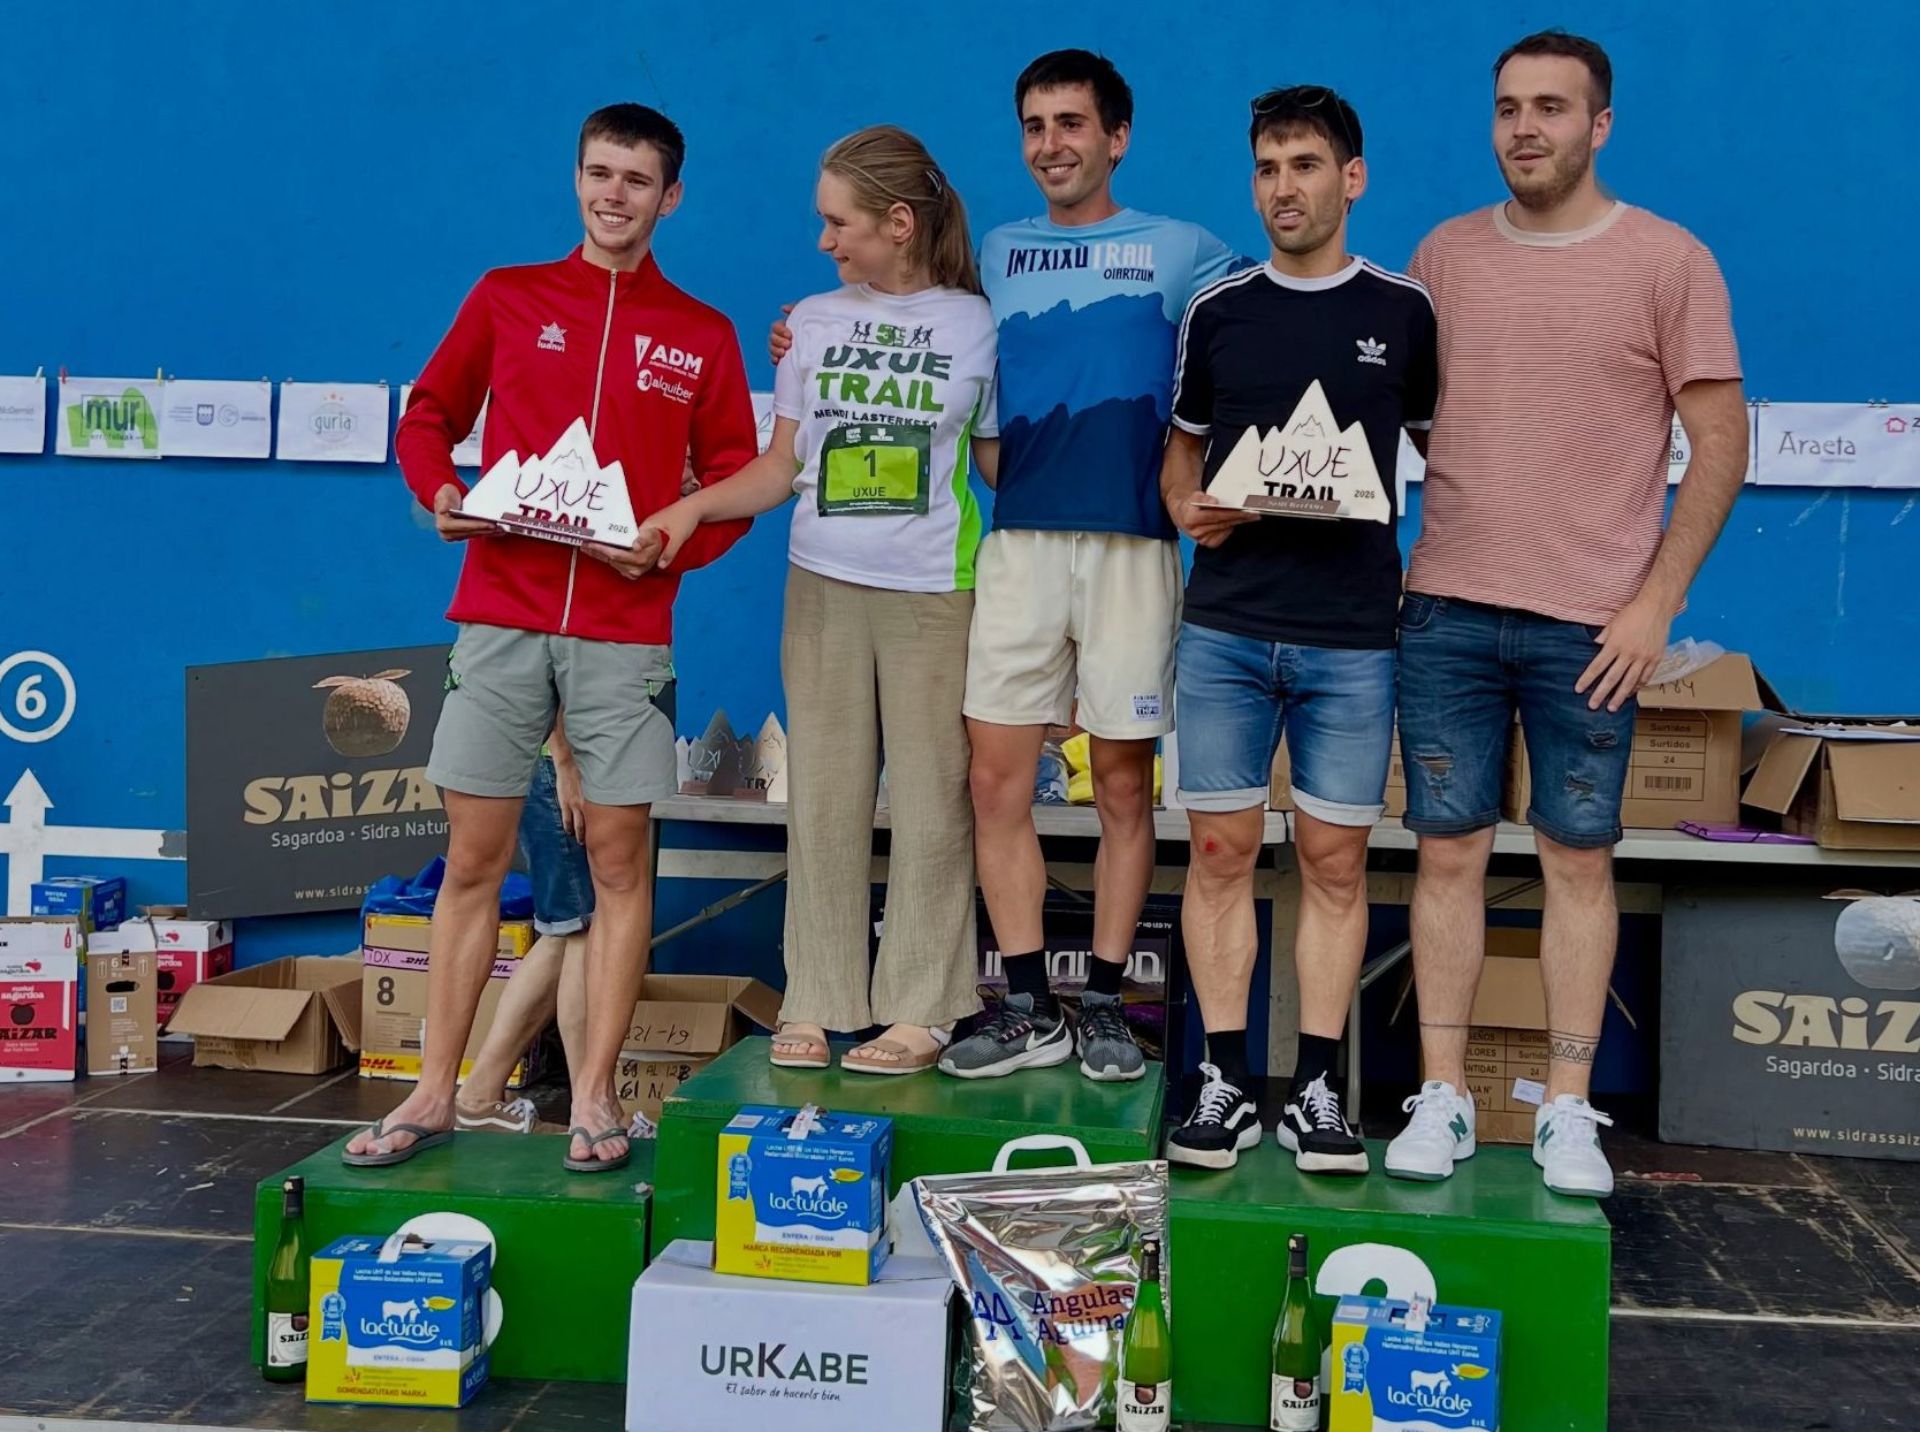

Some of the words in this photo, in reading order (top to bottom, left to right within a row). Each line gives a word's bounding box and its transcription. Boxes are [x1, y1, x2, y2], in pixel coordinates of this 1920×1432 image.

[1006, 245, 1089, 278] INTXIXU
[1092, 239, 1155, 271] TRAIL
[1103, 267, 1154, 283] OIARTZUN
[650, 344, 703, 374] ADM
[822, 344, 952, 380] UXUE
[1357, 355, 1386, 366] adidas
[652, 375, 694, 400] alquiber
[816, 372, 944, 412] TRAIL
[86, 399, 140, 431] mur
[814, 409, 848, 420] MENDI
[1778, 431, 1856, 456] Araeta
[864, 448, 876, 478] 1
[1258, 445, 1352, 484] UXUE
[514, 472, 609, 510] UXUE
[852, 486, 886, 498] UXUE
[16, 674, 46, 720] 6
[1650, 722, 1691, 733] Surtidos
[1650, 739, 1690, 750] Surtidos
[1664, 756, 1675, 764] 24
[271, 828, 345, 850] Sagardoa
[361, 822, 400, 841] Sidra
[377, 976, 395, 1006] 8
[1766, 1055, 1857, 1078] Sagardoa
[769, 1192, 848, 1214] lacturale
[1032, 1285, 1134, 1318] Angulas
[360, 1317, 440, 1337] lacturale
[701, 1342, 869, 1385] URKABE
[726, 1382, 738, 1395] El
[740, 1384, 767, 1396] sabor
[769, 1386, 781, 1398] de
[783, 1386, 819, 1400] hacerlo
[821, 1390, 841, 1402] bien
[1388, 1386, 1473, 1412] lacturale
